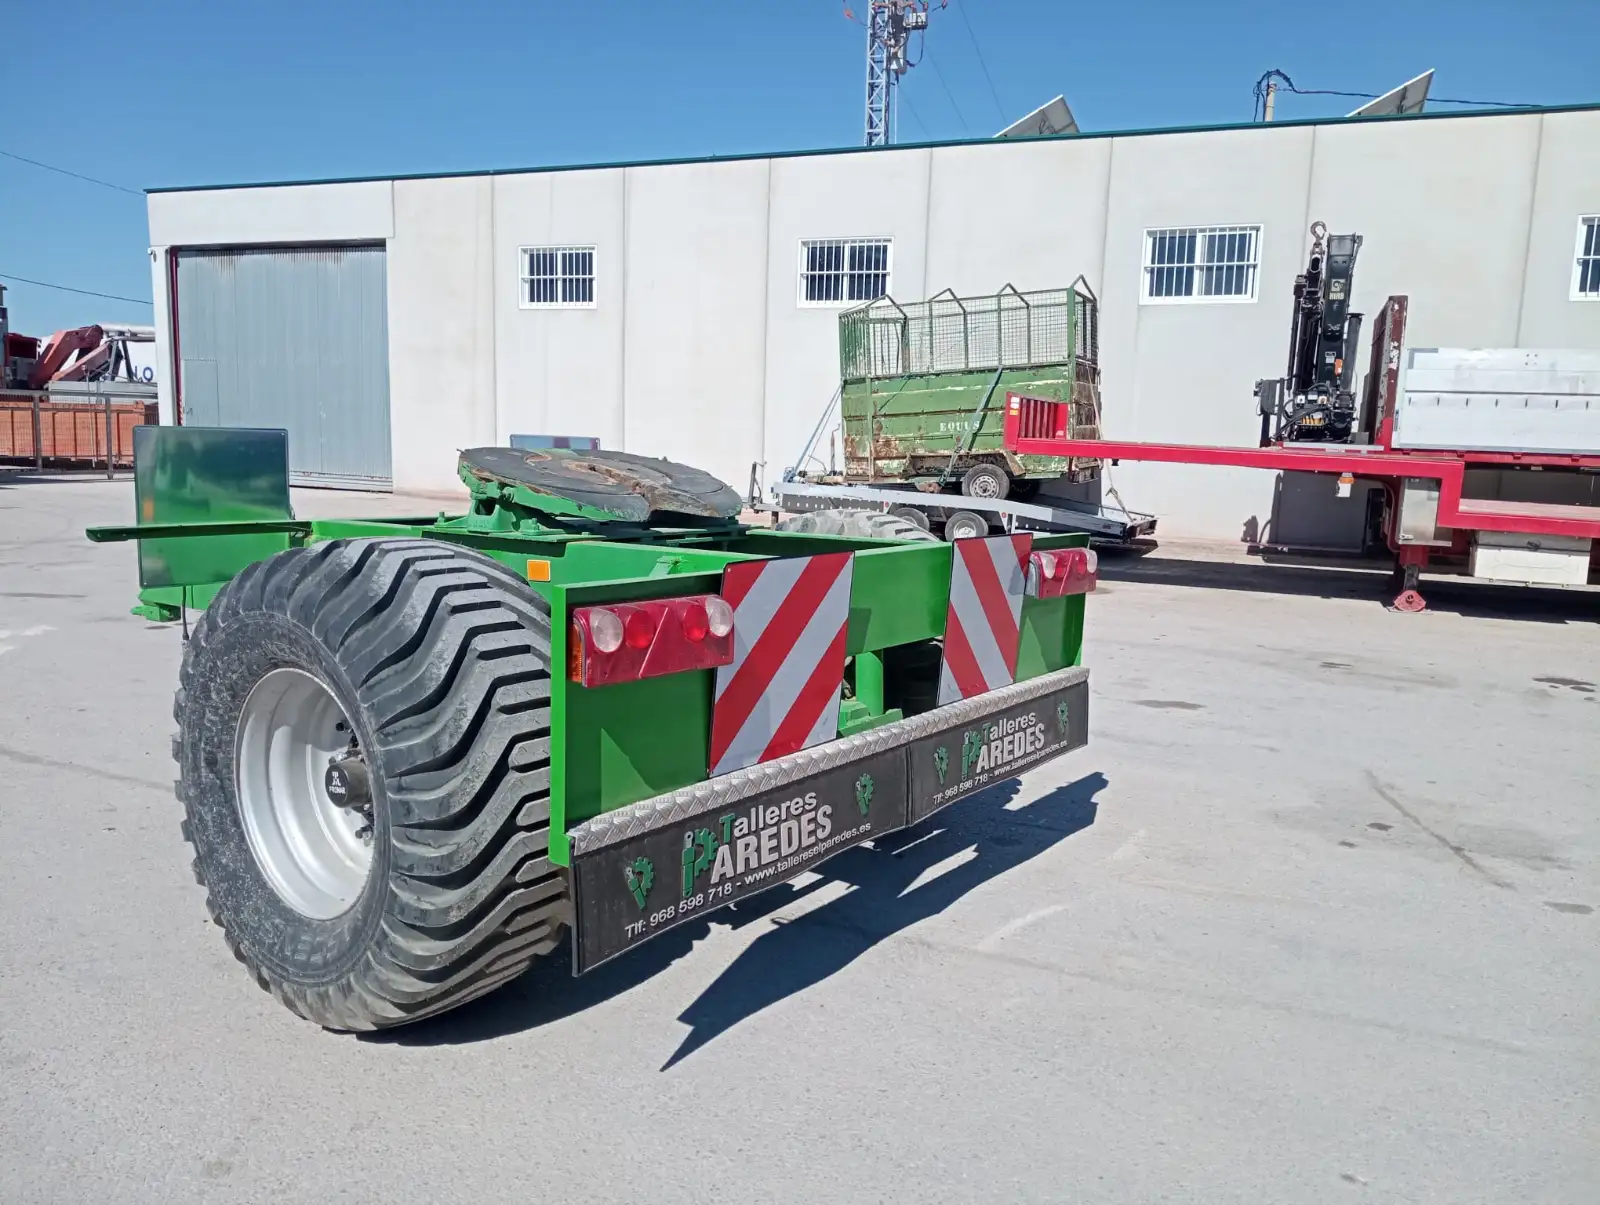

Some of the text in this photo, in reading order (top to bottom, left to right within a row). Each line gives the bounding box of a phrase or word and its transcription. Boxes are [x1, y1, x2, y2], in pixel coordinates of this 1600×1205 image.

[982, 712, 1036, 743] Talleres
[945, 785, 958, 799] 968
[959, 779, 973, 792] 598
[974, 773, 988, 786] 718
[719, 792, 817, 843] Talleres
[624, 919, 647, 938] Tlf:
[650, 905, 675, 926] 968
[679, 893, 704, 914] 598
[707, 882, 732, 904] 718
